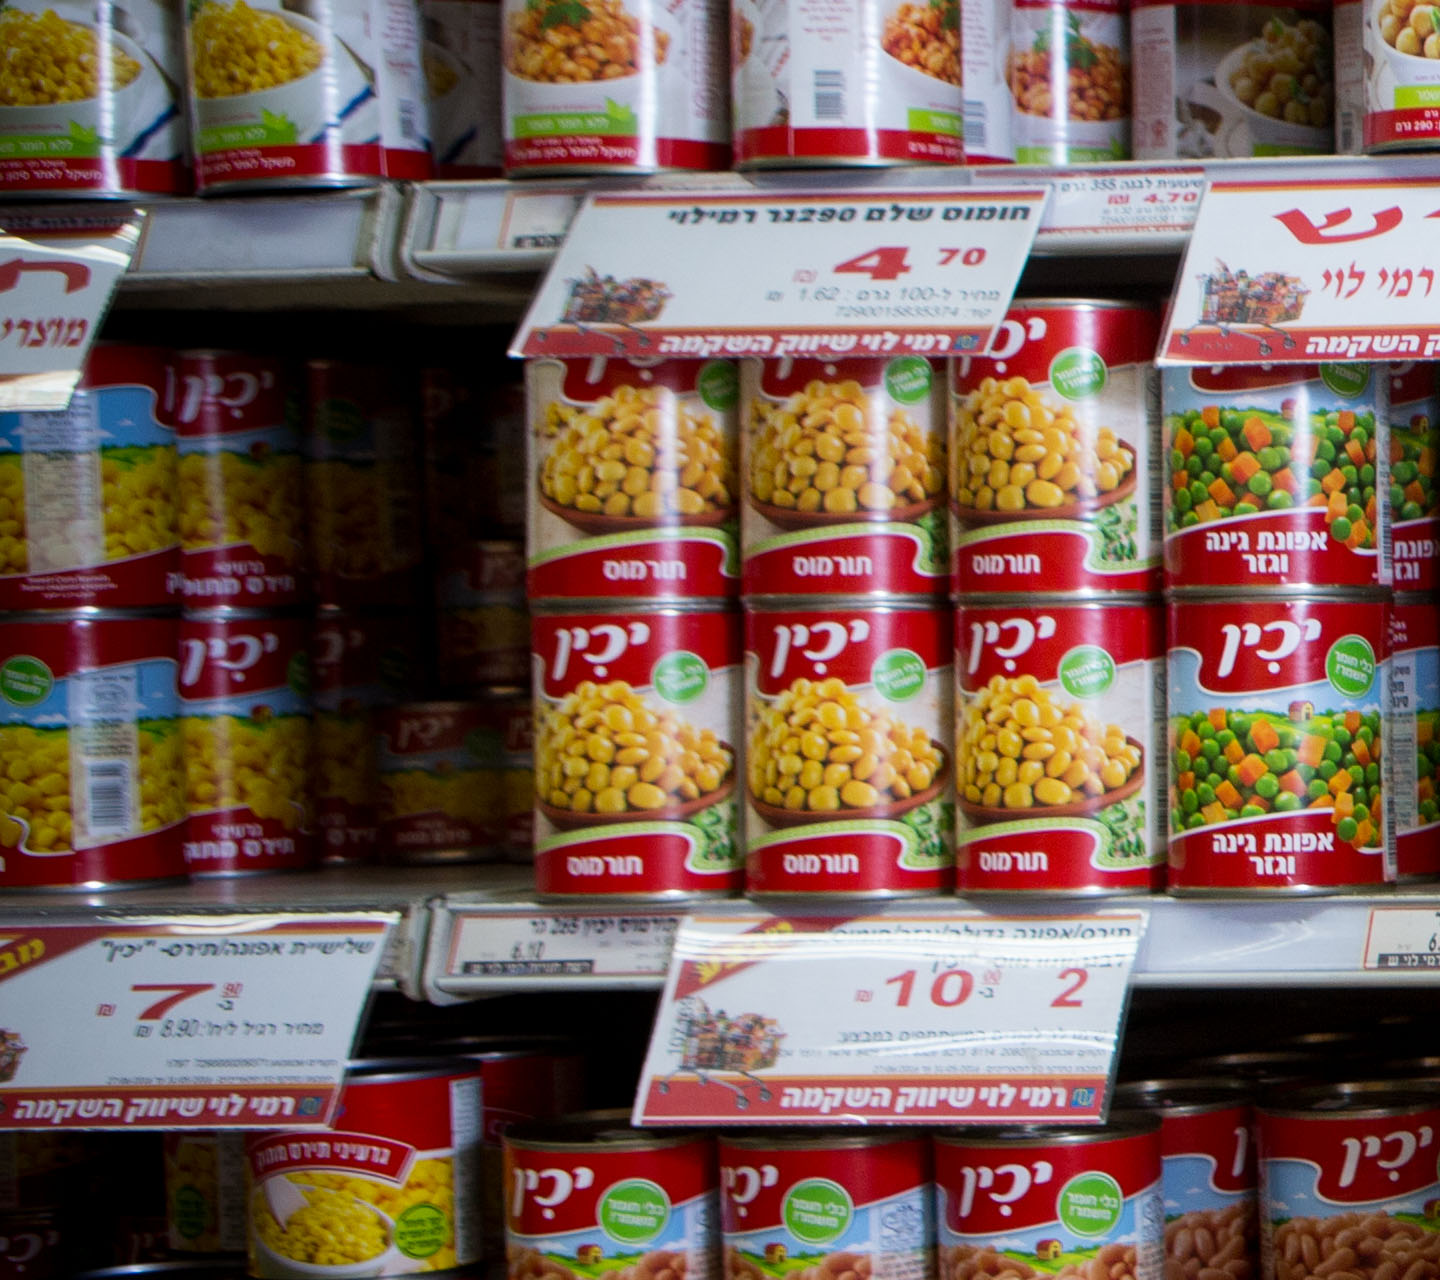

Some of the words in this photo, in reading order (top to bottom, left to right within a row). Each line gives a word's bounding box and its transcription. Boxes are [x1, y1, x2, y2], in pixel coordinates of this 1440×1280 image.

[833, 246, 911, 280] 4
[937, 247, 986, 266] 70
[1320, 259, 1366, 300] לוי
[1379, 267, 1433, 300] רמי
[1306, 331, 1419, 354] השקמה
[603, 558, 687, 582] תורמוס
[793, 554, 873, 577] תורמוס
[1213, 834, 1256, 854] גינה
[1263, 832, 1334, 853] אפונת
[980, 851, 1048, 873] תורמוס
[1249, 854, 1296, 876] וגזר
[288, 938, 374, 954] שלישיית
[885, 969, 976, 1007] 10
[1050, 968, 1090, 1008] 2
[131, 983, 216, 1020] 7
